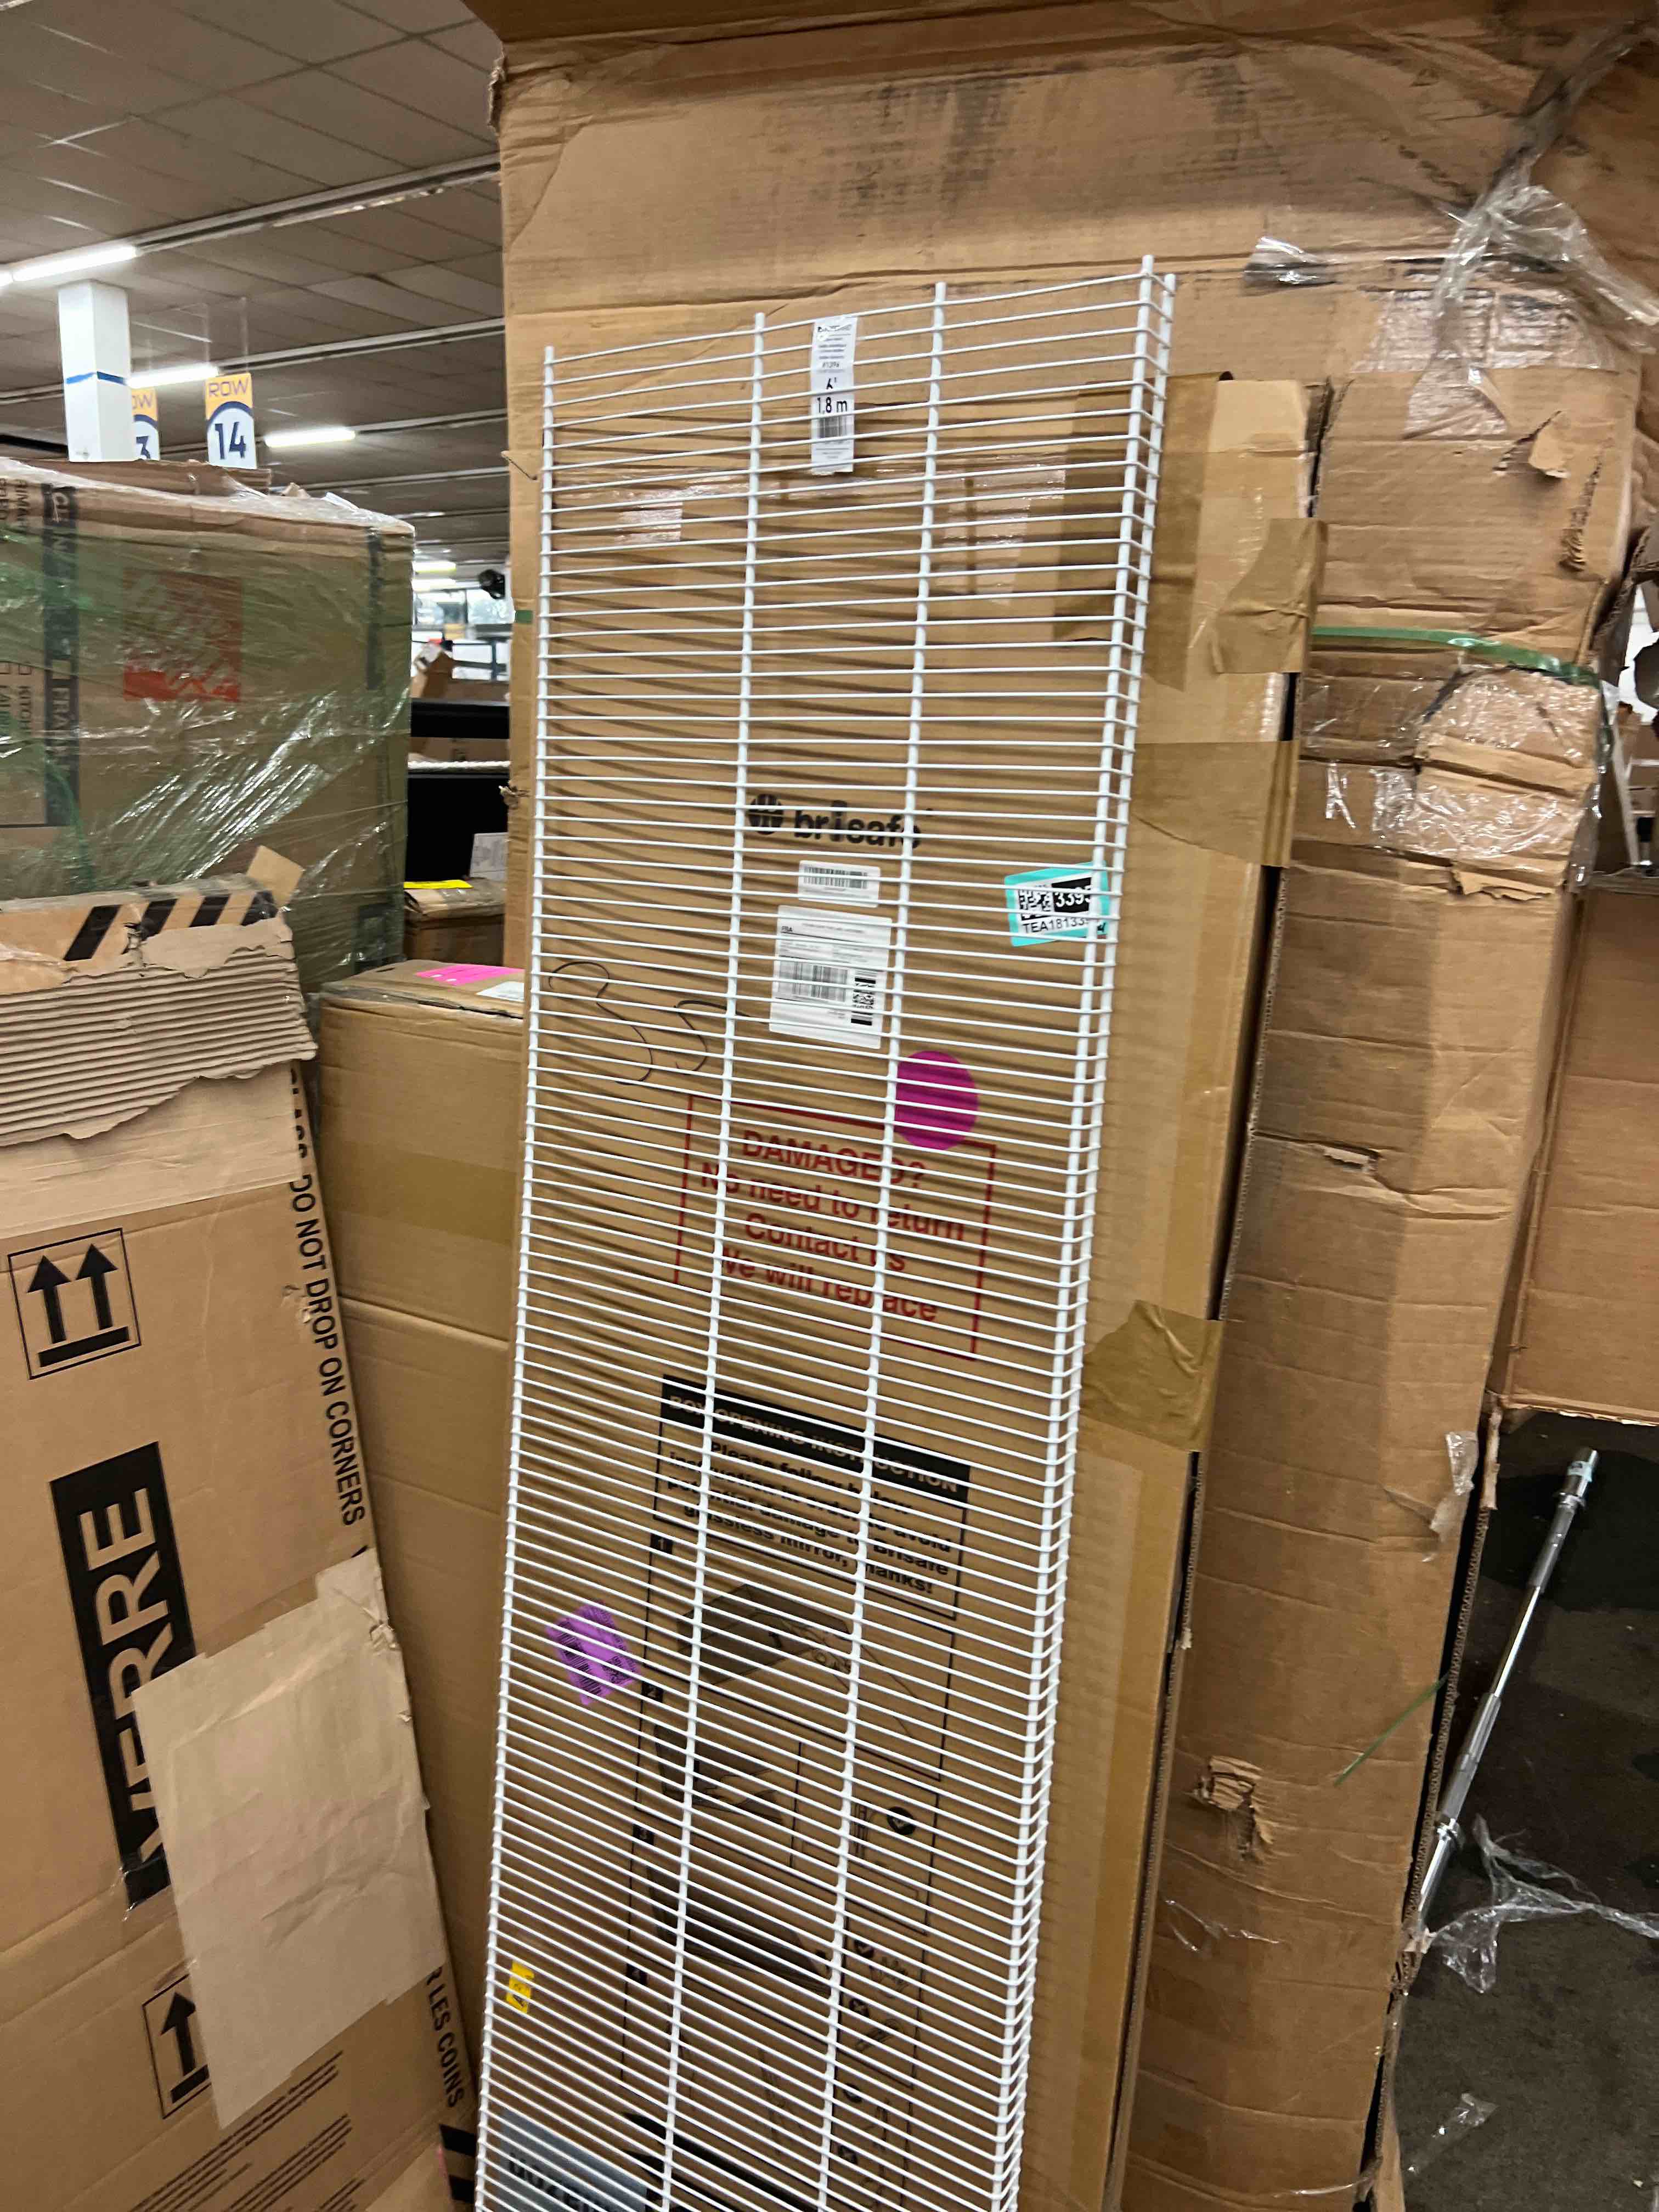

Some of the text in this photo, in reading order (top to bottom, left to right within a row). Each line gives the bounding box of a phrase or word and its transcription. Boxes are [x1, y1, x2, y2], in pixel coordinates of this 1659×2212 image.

[208, 377, 250, 397] ROW
[837, 400, 848, 413] m
[215, 421, 246, 460] 14
[289, 1173, 317, 1212] DO
[749, 1179, 822, 1211] need
[831, 1189, 860, 1218] to
[295, 1218, 327, 1270] NOT
[744, 1212, 860, 1262] Contact
[305, 1277, 339, 1350] DROP
[823, 1280, 937, 1321] repace
[319, 1356, 347, 1397] ON
[325, 1400, 366, 1526] CORNERS
[811, 1436, 957, 1492] INSTUCTION
[428, 1983, 450, 2031] LES
[437, 2032, 465, 2108] COINS
